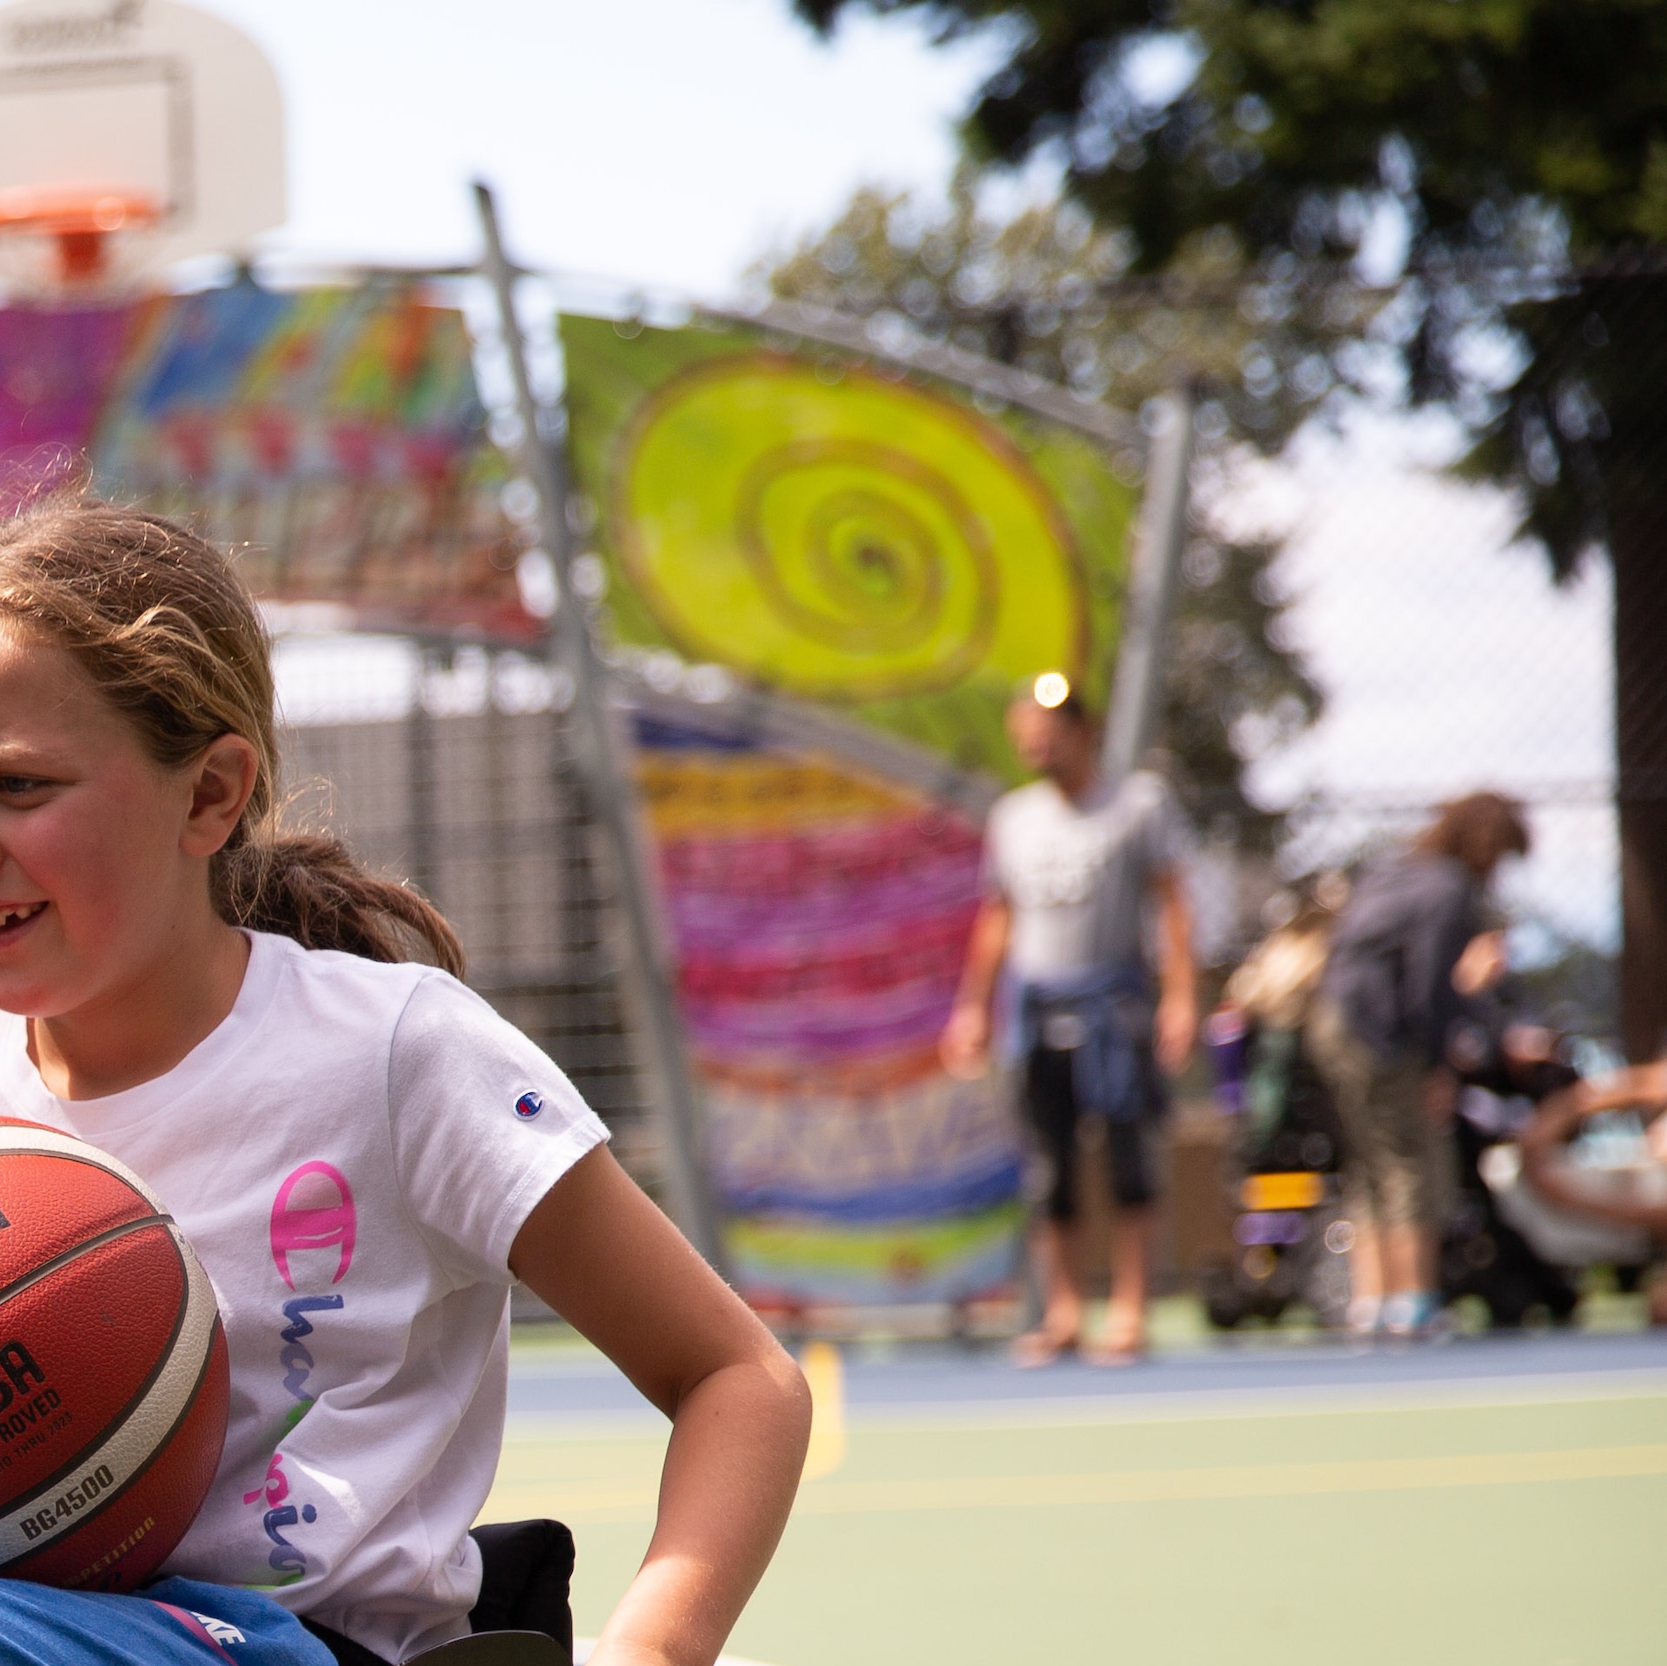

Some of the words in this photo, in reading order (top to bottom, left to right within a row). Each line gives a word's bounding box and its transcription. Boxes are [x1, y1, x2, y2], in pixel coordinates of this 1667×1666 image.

[243, 1160, 357, 1588] Chapio
[14, 1432, 46, 1459] THRU
[19, 1464, 115, 1542] BG4500
